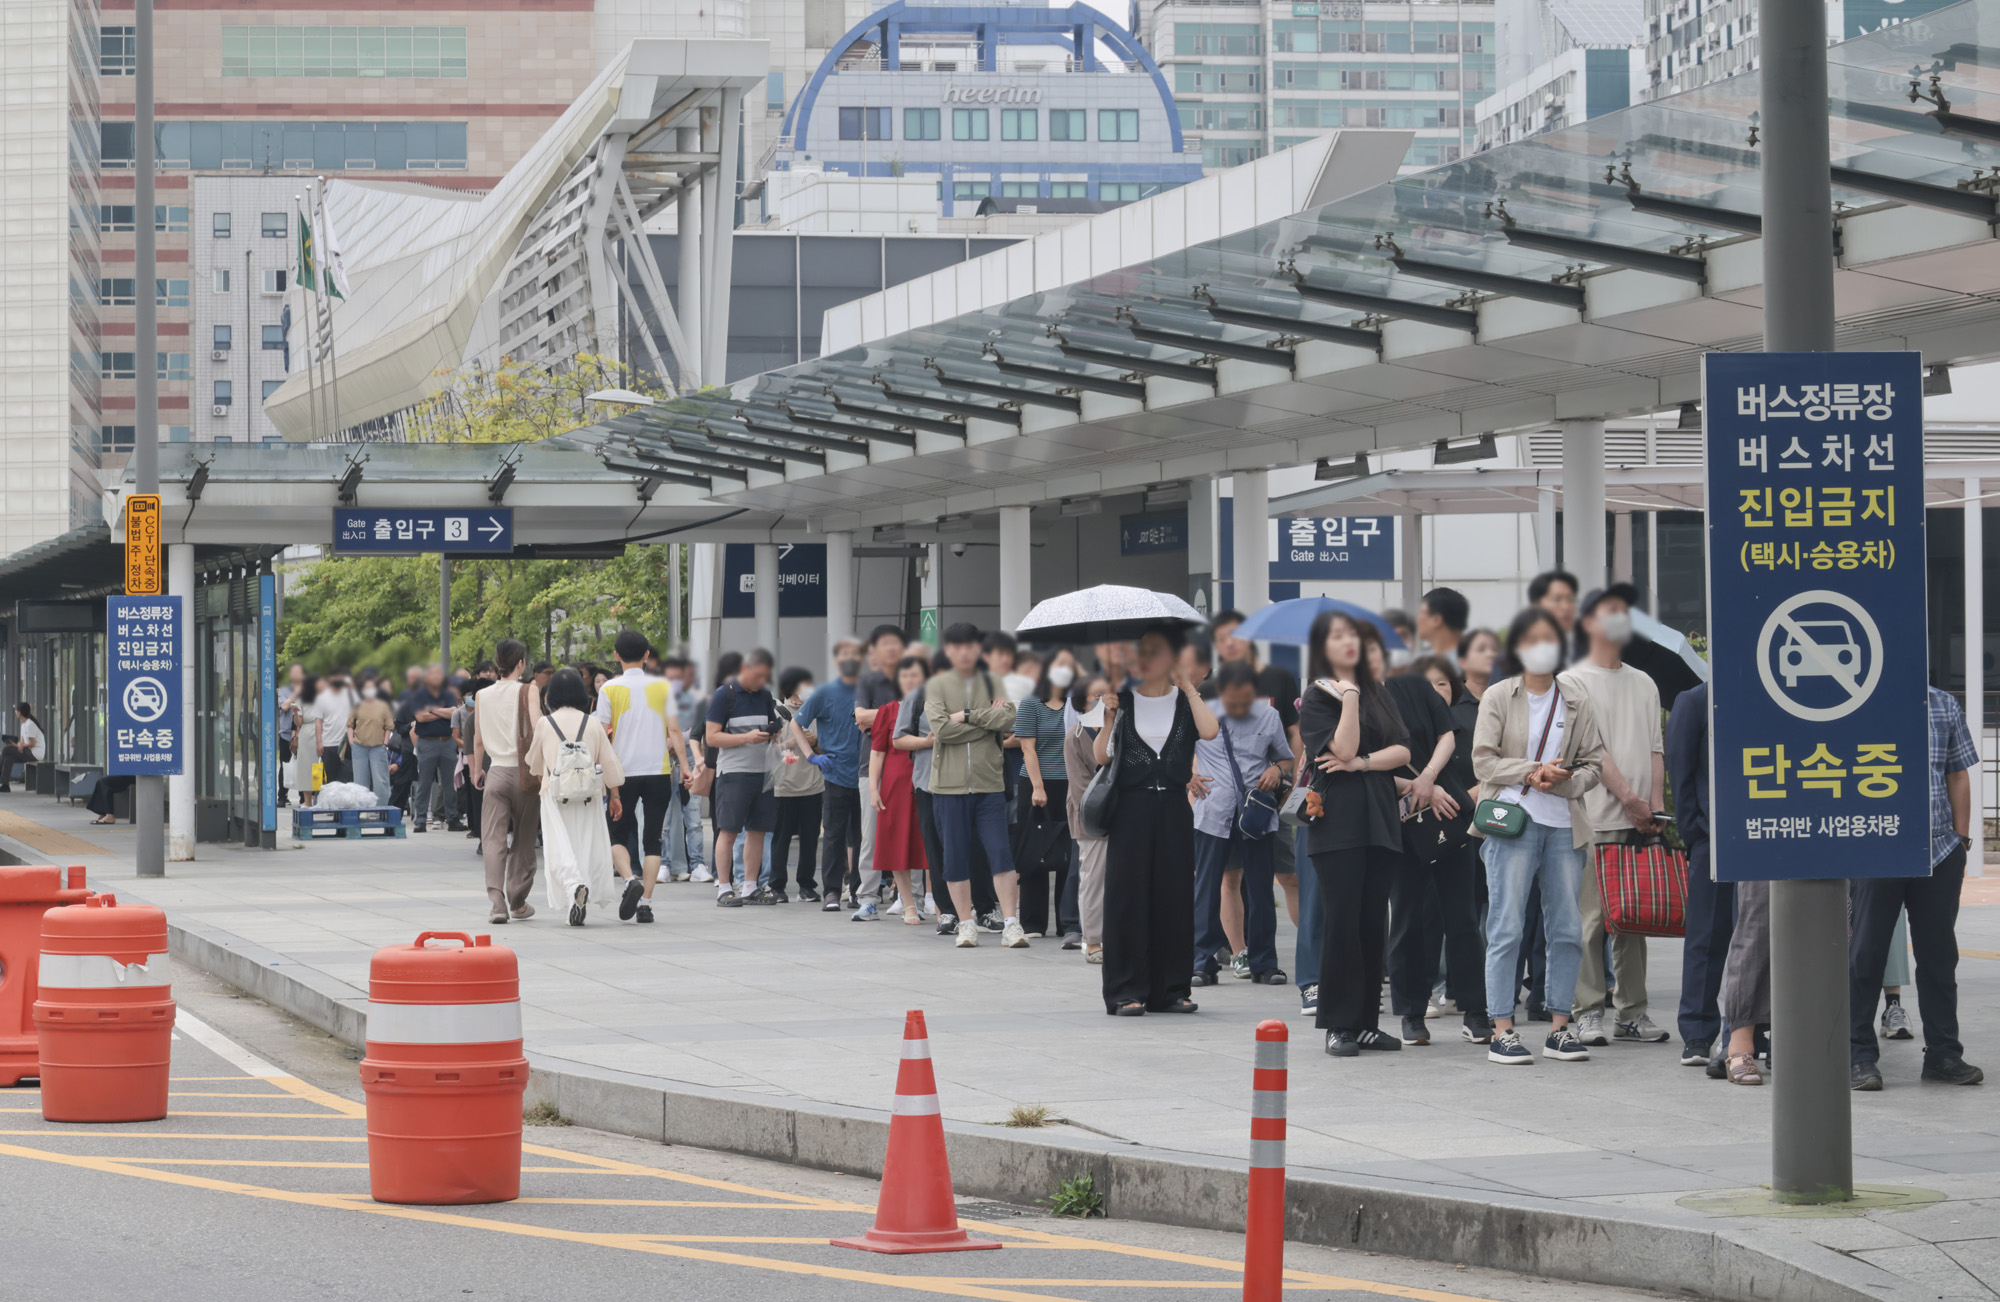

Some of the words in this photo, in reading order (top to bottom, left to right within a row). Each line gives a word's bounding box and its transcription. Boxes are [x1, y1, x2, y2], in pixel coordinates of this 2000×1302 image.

[943, 80, 1041, 104] heerim
[1737, 382, 1896, 422] 버스정류장
[1738, 485, 1895, 527] 진입금지
[347, 519, 366, 528] Gate
[373, 518, 435, 540] 출입구
[451, 520, 462, 538] 3
[1289, 517, 1380, 547] 출입구
[342, 531, 366, 540] 出入口
[1290, 549, 1315, 562] Gate
[1320, 550, 1349, 562] 出入口
[1740, 539, 1896, 572] (택시·승용차)
[778, 573, 819, 585] 리베이터
[117, 606, 173, 620] 버스정류장
[117, 641, 172, 656] 진입금지
[117, 728, 174, 749] 단속중
[1742, 743, 1902, 799] 단속중
[1746, 816, 1812, 840] 법규위반
[1817, 814, 1900, 838] 사업용차량
